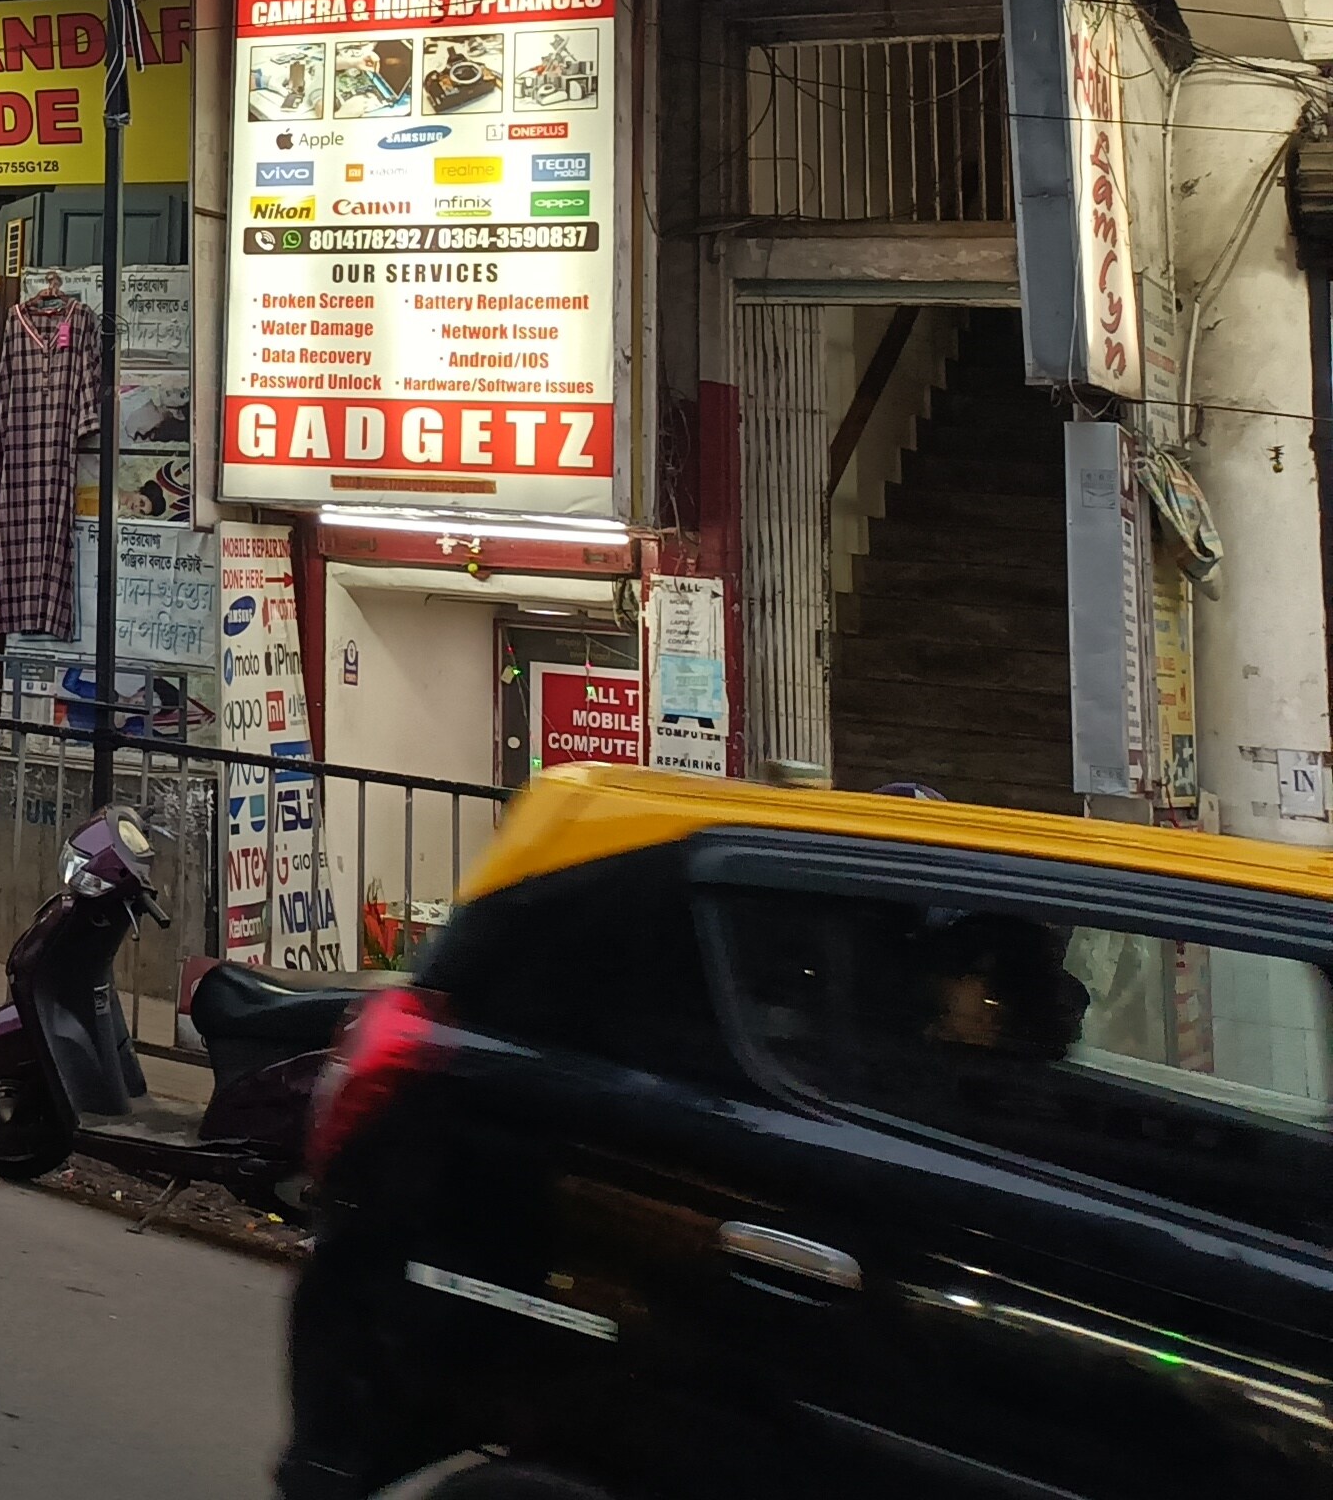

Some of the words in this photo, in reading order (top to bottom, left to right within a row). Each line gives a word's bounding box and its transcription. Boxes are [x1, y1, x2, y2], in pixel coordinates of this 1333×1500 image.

[351, 0, 370, 21] &
[385, 130, 444, 145] SAMSUNG
[511, 124, 565, 139] ONEPLUS
[299, 132, 344, 150] Apple
[260, 167, 310, 180] vivo
[441, 164, 495, 177] realme
[253, 203, 312, 220] Nikon
[332, 199, 411, 216] Canon
[434, 196, 492, 209] Infinix
[309, 229, 421, 250] 8014178292
[437, 226, 588, 249] 0364-3590837
[332, 263, 376, 283] OUR
[385, 262, 499, 283] SERVICES
[262, 293, 315, 309] Broken
[319, 293, 375, 310] Screen
[414, 294, 473, 311] Battery
[477, 294, 589, 312] Replacement
[261, 320, 307, 336] Water
[310, 320, 374, 338] Damage
[441, 323, 508, 339] Network
[513, 324, 559, 340] Issue
[261, 349, 295, 364] Data
[299, 349, 372, 367] Recovery
[448, 352, 549, 369] Android/IOS
[250, 373, 324, 389] Password
[328, 374, 382, 391] Unlock
[404, 377, 541, 394] Hardware/Software
[237, 403, 595, 469] GADGETZ
[222, 538, 250, 557] MOBILE
[222, 569, 243, 589] DONE
[245, 569, 264, 589] HERE
[228, 607, 253, 624] SAMSUNG
[235, 649, 260, 677] moto
[585, 686, 620, 705] ALL
[572, 709, 640, 732] MOBILE
[548, 732, 639, 758] COMPUTE
[656, 755, 722, 772] REPAIRING
